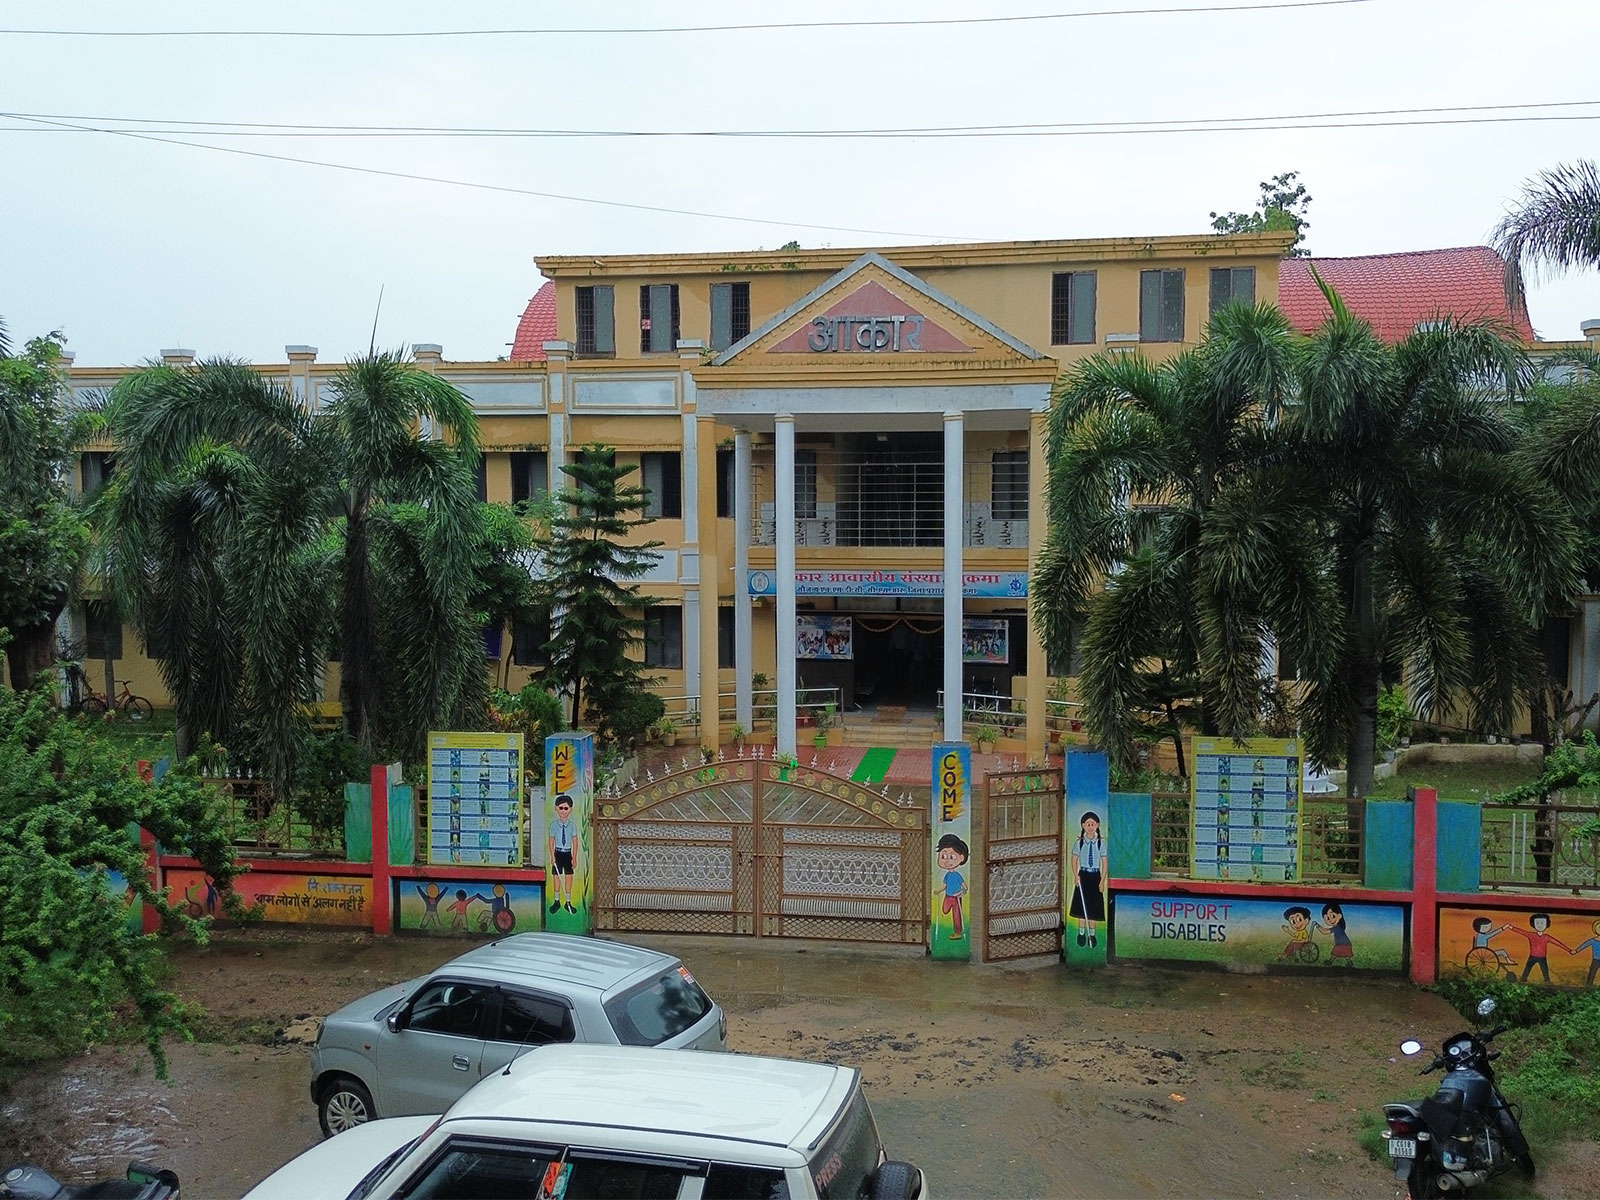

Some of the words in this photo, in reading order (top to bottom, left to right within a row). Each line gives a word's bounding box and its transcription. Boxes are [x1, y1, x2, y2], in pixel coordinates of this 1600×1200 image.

[808, 315, 925, 352] आकार
[795, 573, 822, 582] कार
[827, 569, 895, 582] आवासीय
[555, 745, 569, 796] WEL
[942, 753, 957, 823] COME
[312, 896, 338, 909] अलग
[338, 895, 357, 912] नहीं
[357, 895, 366, 912] है
[1151, 901, 1233, 920] SUPPORT
[1151, 921, 1227, 942] DISABLES
[815, 1151, 842, 1193] PRESS
